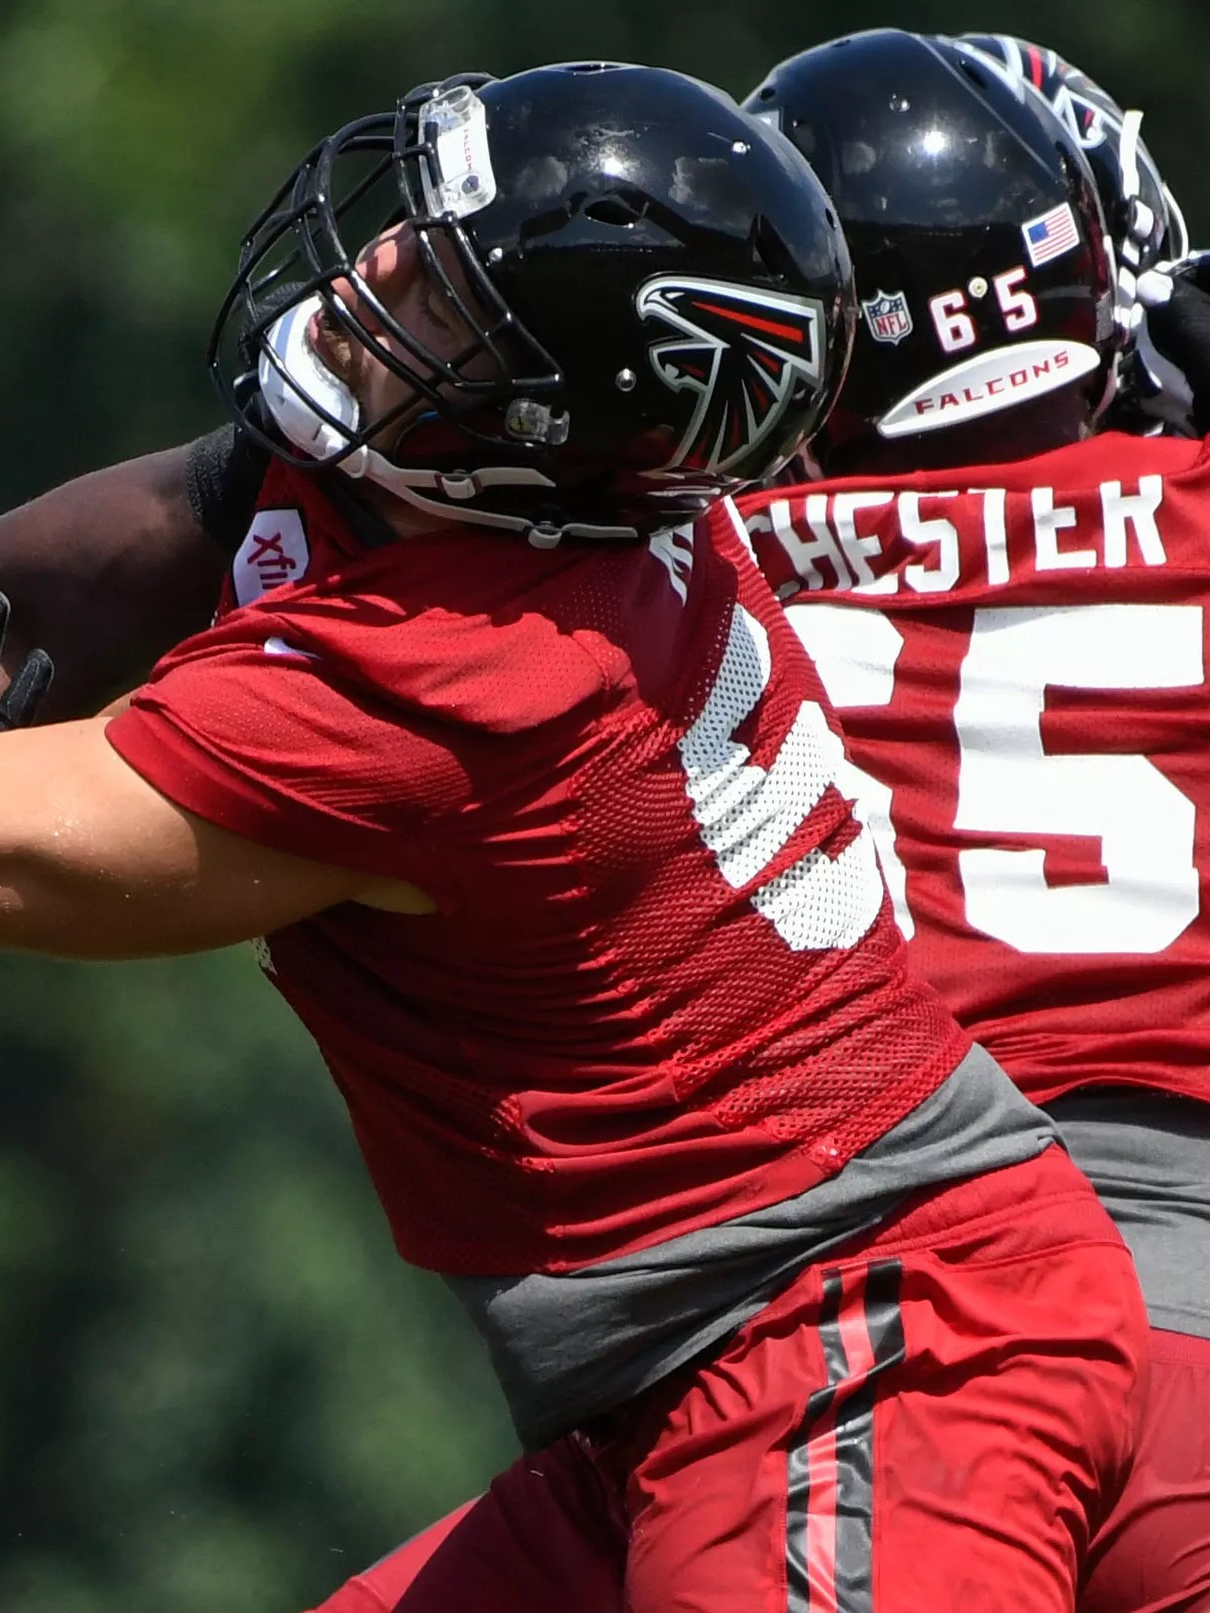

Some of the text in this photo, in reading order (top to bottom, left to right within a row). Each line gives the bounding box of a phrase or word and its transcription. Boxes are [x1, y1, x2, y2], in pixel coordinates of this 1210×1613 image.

[463, 128, 474, 172] FALCON
[875, 312, 908, 337] NFL
[928, 265, 1038, 353] 65
[913, 350, 1070, 416] FALCONS
